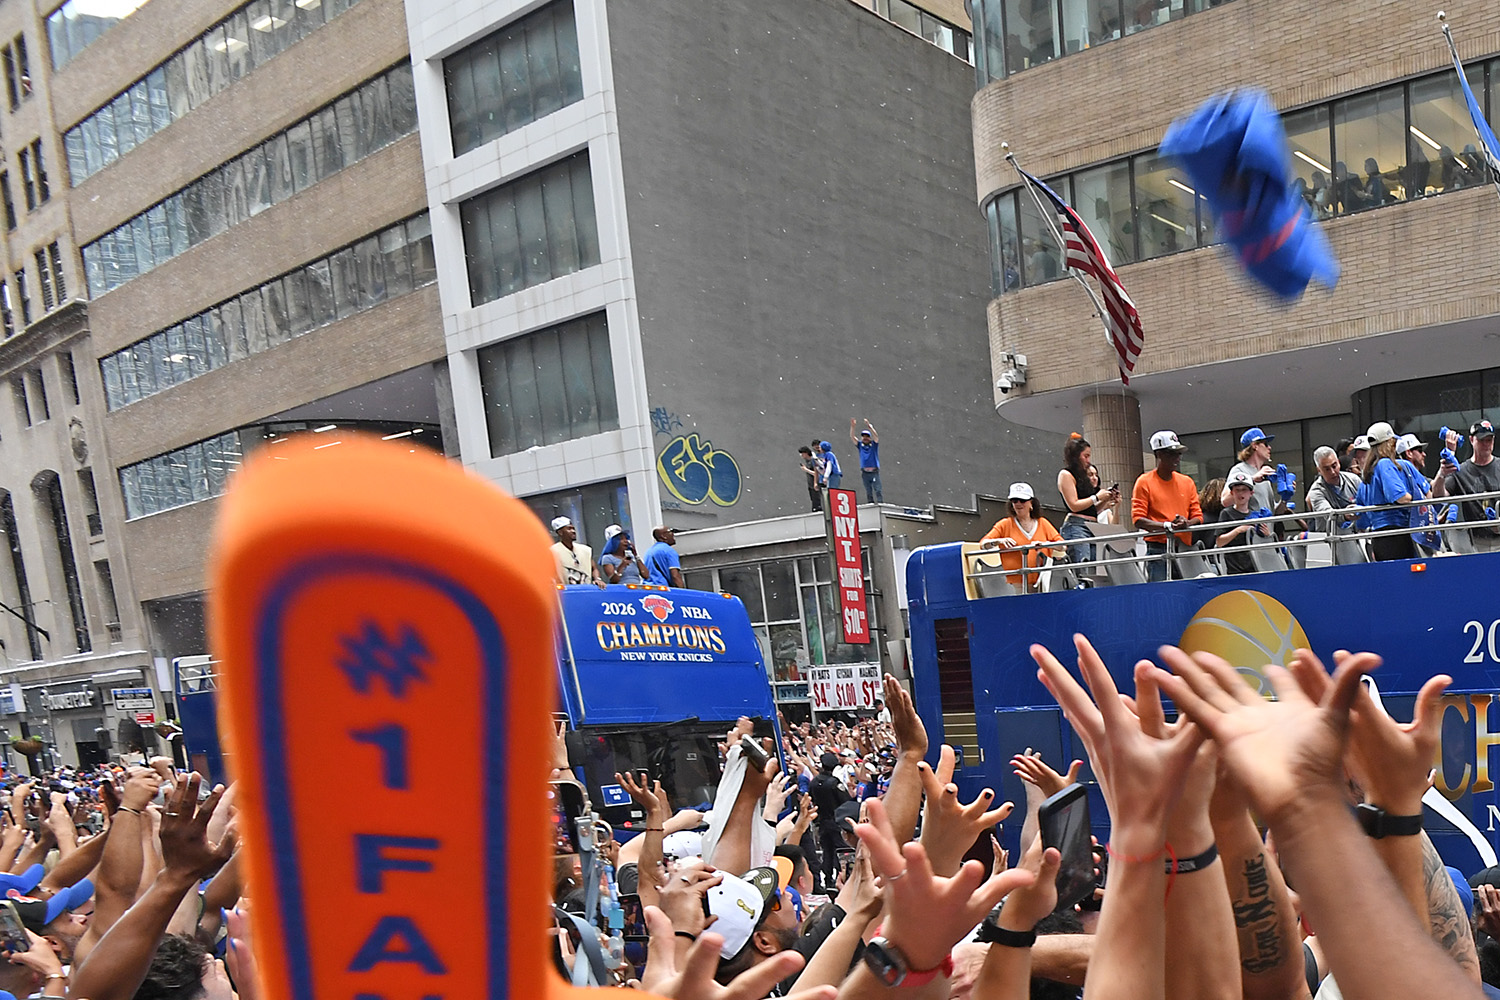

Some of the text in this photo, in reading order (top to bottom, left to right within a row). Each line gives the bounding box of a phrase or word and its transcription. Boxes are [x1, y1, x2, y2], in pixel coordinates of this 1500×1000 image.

[837, 493, 850, 515] 3
[834, 516, 856, 539] NY
[839, 566, 863, 589] SHIRTS
[846, 590, 859, 602] FOR
[601, 602, 712, 620] 2026 NBA
[596, 621, 726, 655] CHAMPIONS
[620, 651, 714, 663] NEW YORK KNICKS
